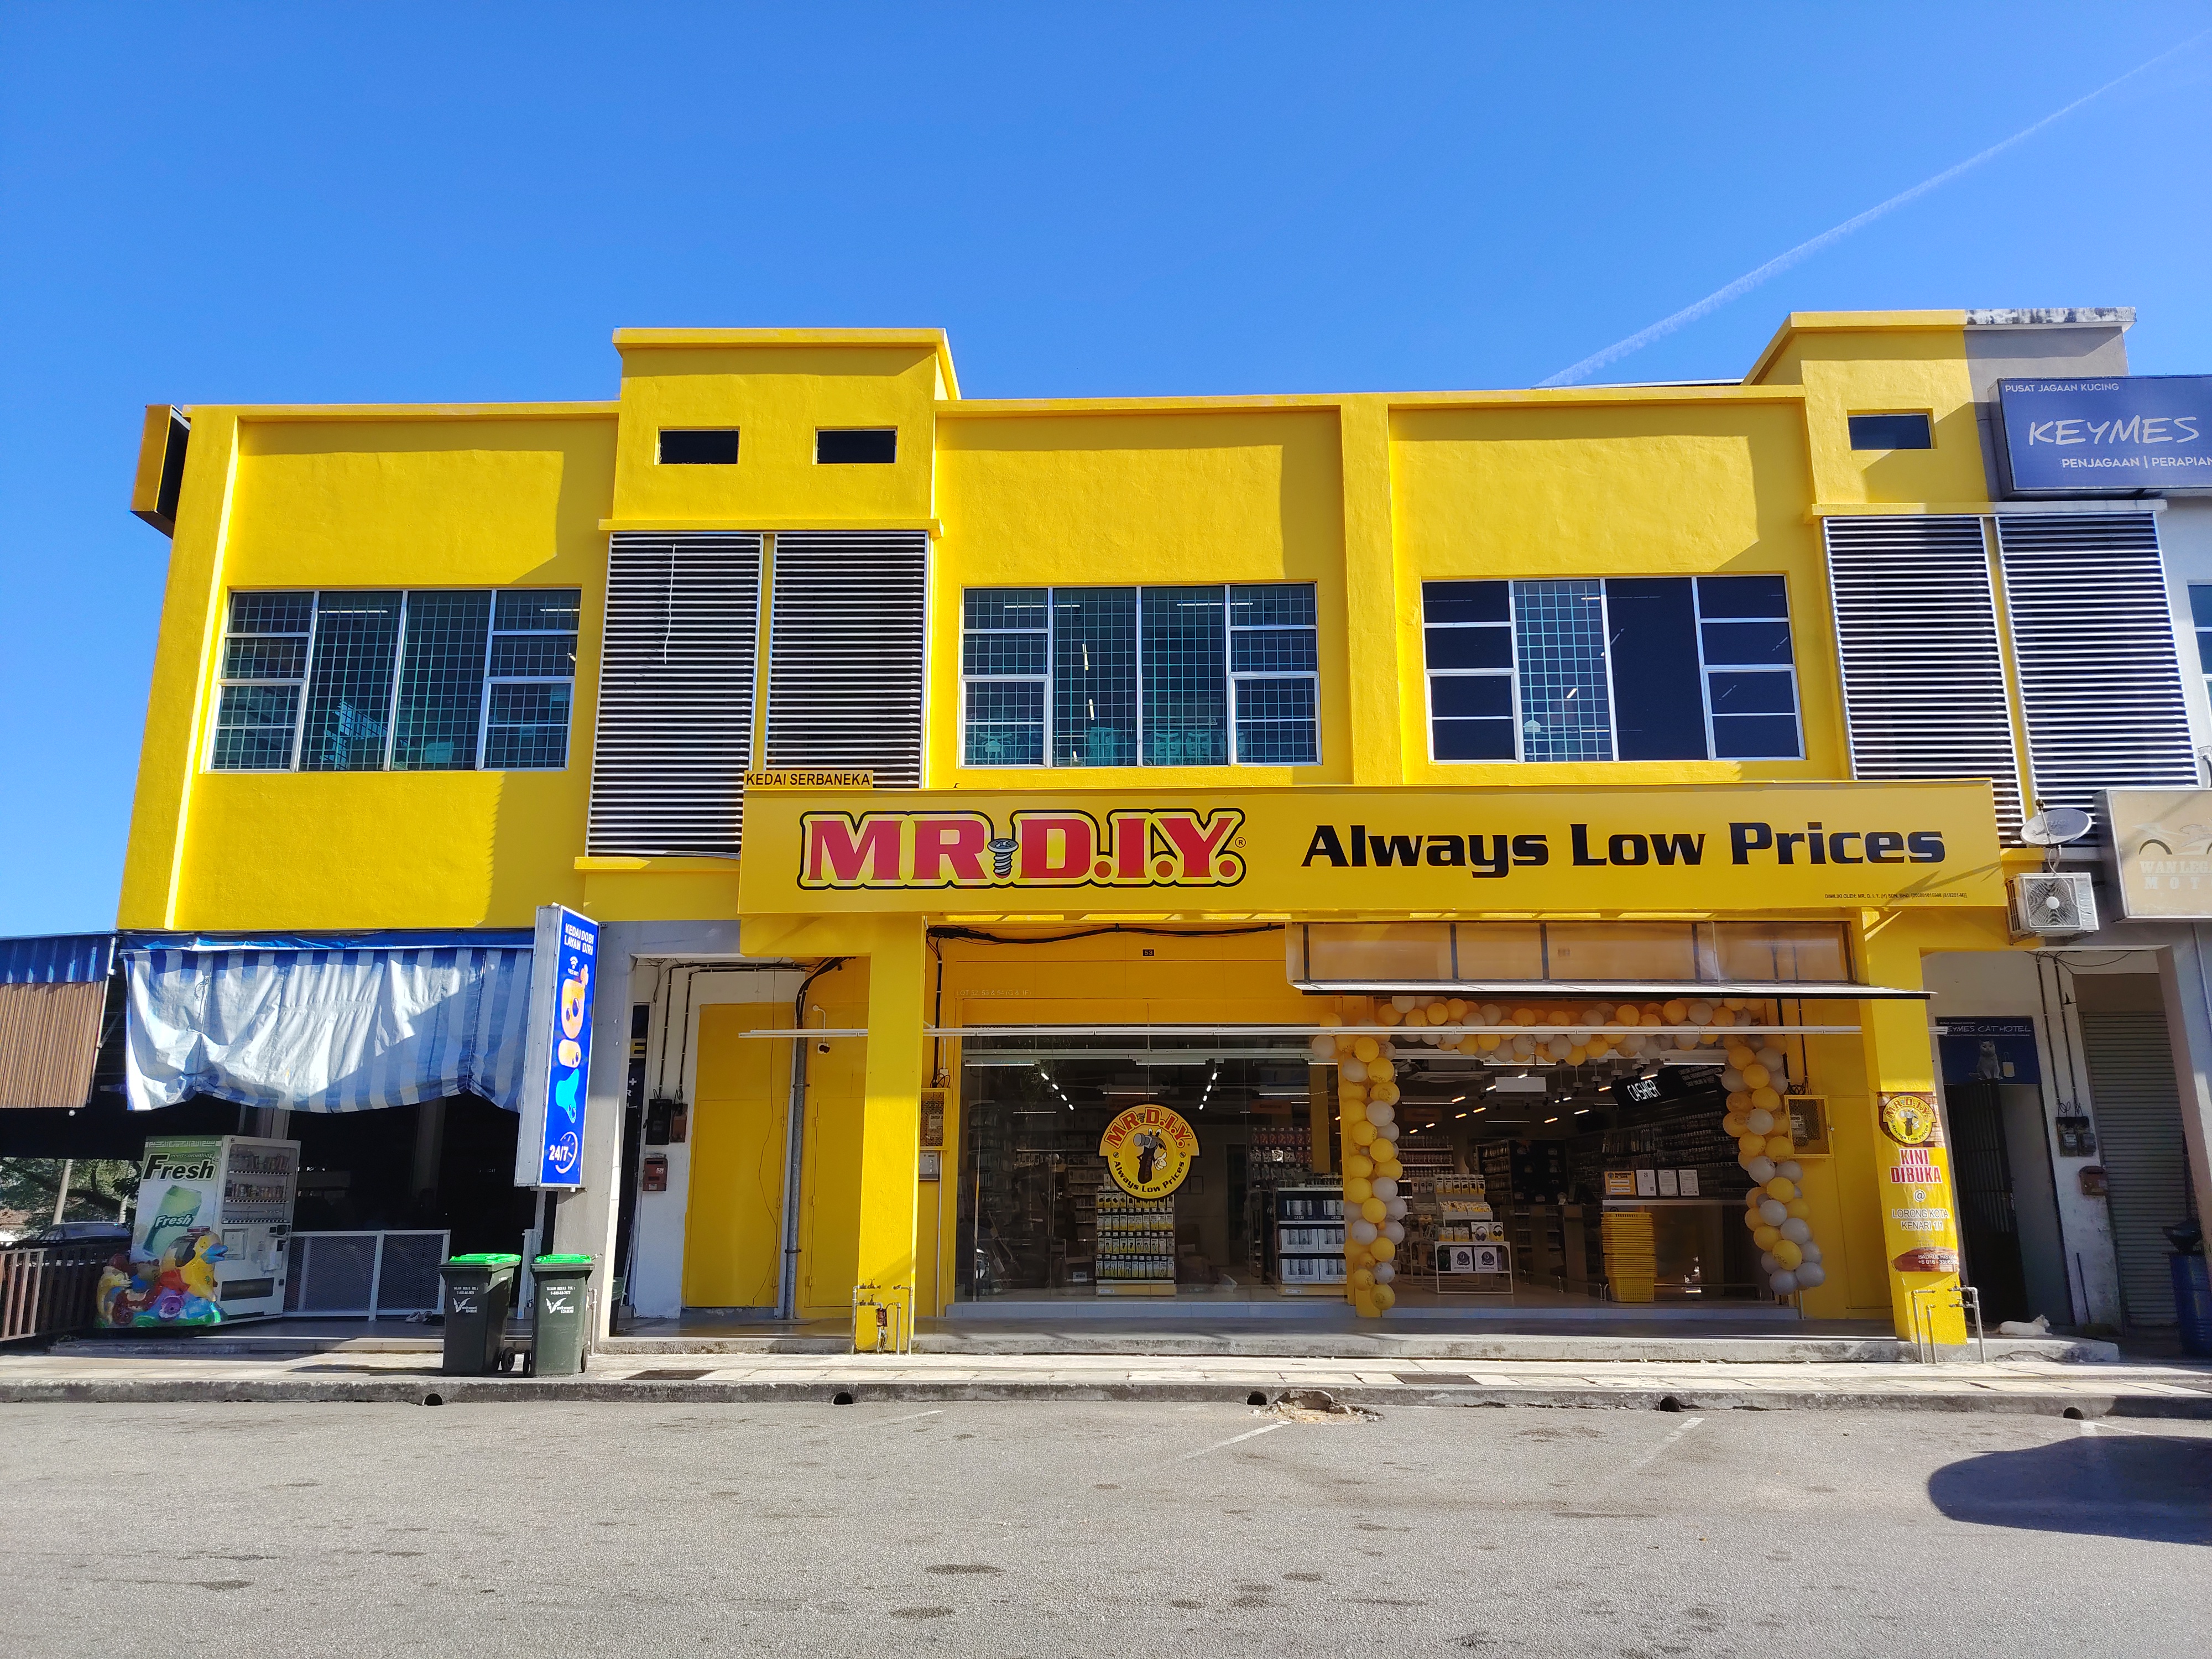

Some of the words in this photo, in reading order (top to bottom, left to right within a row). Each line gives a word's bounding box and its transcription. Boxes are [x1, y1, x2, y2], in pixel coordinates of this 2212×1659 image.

[2038, 384, 2078, 392] JAGAAN
[2080, 383, 2120, 391] KUCING
[2029, 415, 2199, 446] KEYMES
[2062, 458, 2140, 468] PENJAGAAN
[747, 773, 786, 785] KEDAI
[790, 773, 870, 785] SERBANEKA
[1301, 825, 1549, 878] Always
[1569, 823, 1707, 866] Low
[1728, 821, 1946, 865] Prices
[565, 923, 581, 939] KEDAI
[581, 930, 594, 945] DOBI
[564, 935, 581, 951] LAYAN
[582, 942, 593, 956] DIRI
[1627, 1079, 1661, 1102] CASHIER
[1891, 1124, 1906, 1139] Always
[1918, 1125, 1929, 1139] Prices
[549, 1145, 569, 1161] 24/7
[1900, 1149, 1929, 1165] KINI
[142, 1154, 216, 1180] Fresh
[1114, 1160, 1139, 1190] Always
[1162, 1161, 1185, 1188] Prices
[1890, 1167, 1942, 1182] DIBUKA
[155, 1214, 194, 1227] Fresh
[1892, 1209, 1928, 1218] LORONG
[1929, 1209, 1949, 1218] KOTA
[1901, 1221, 1931, 1230] KENARI
[1933, 1221, 1943, 1230] 1/1
